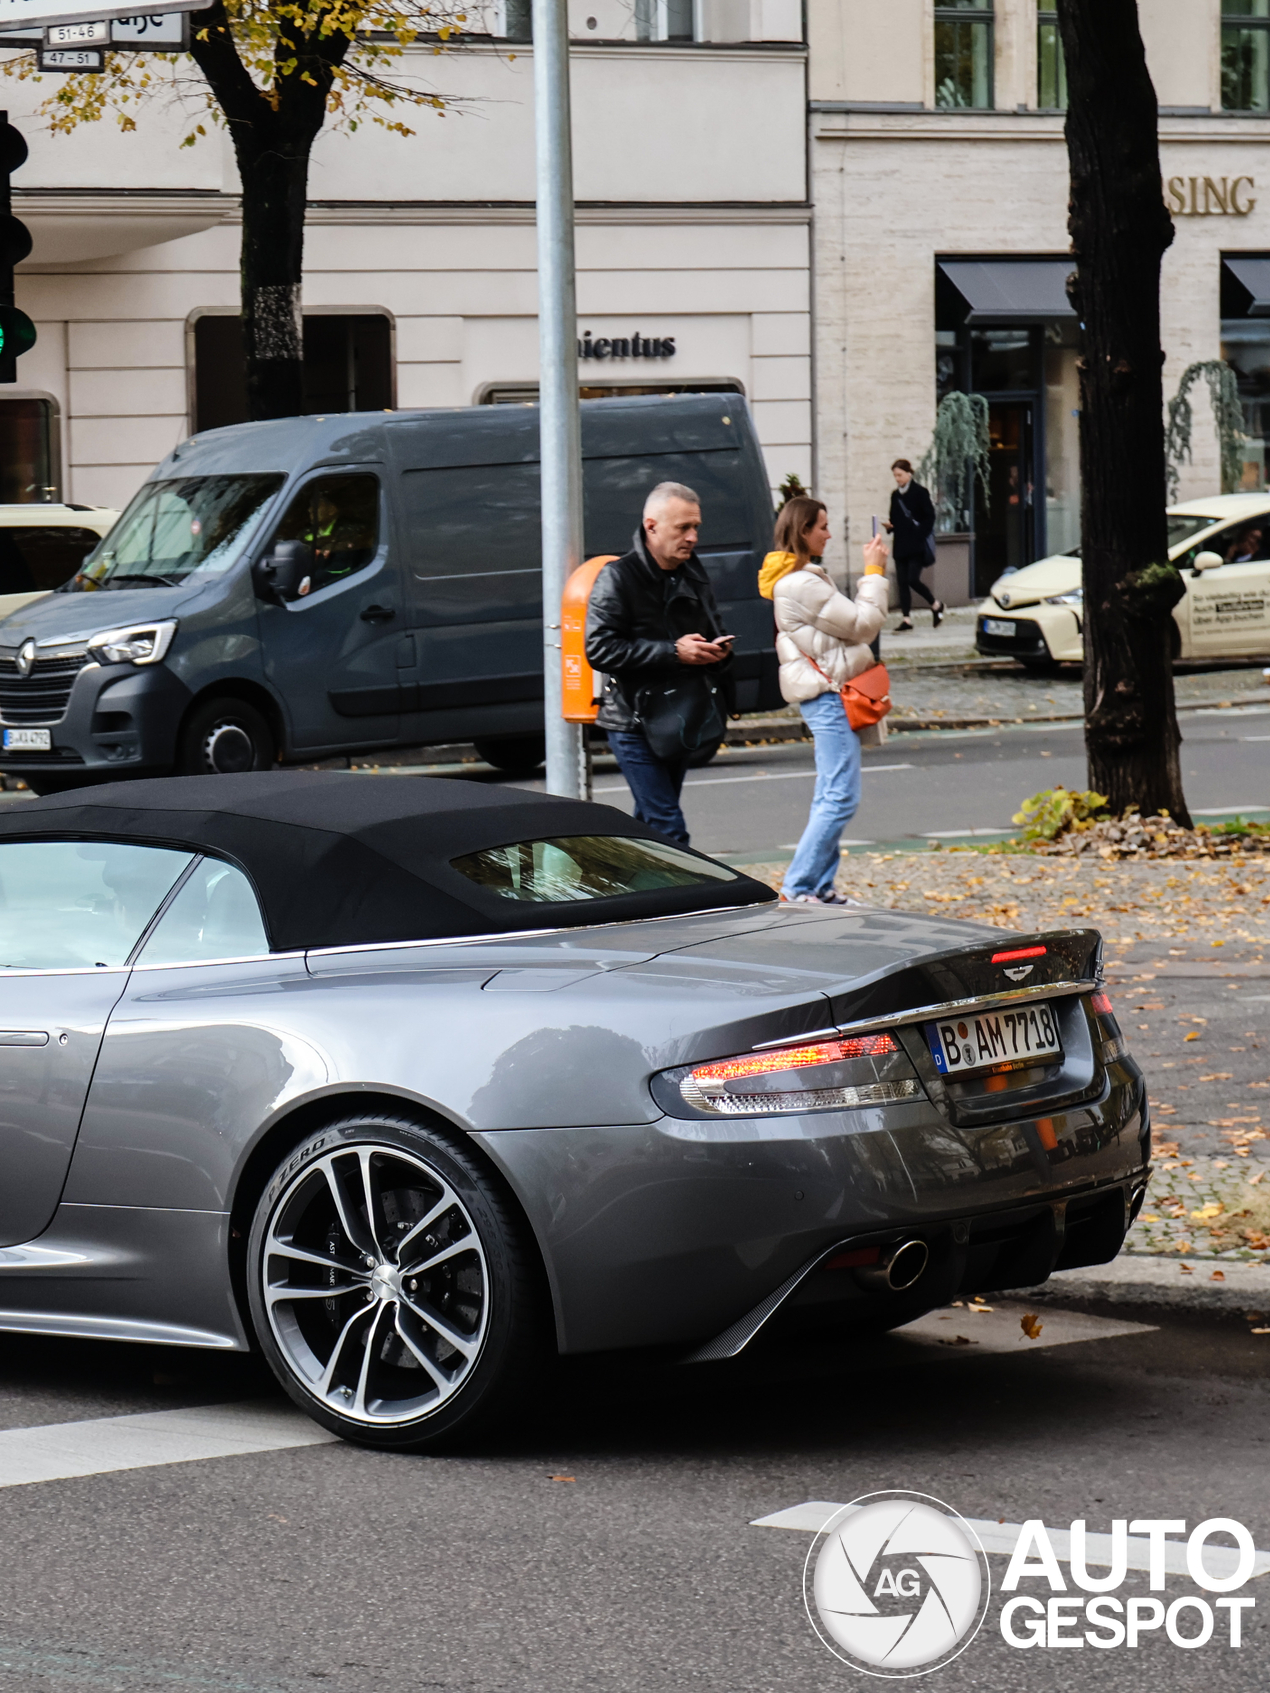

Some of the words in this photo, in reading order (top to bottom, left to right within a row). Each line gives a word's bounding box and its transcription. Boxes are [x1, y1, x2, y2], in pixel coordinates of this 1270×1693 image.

[941, 1025, 961, 1066] B
[975, 1017, 1007, 1061] AM
[1004, 1008, 1056, 1054] 7718
[278, 1137, 326, 1185] ZERO
